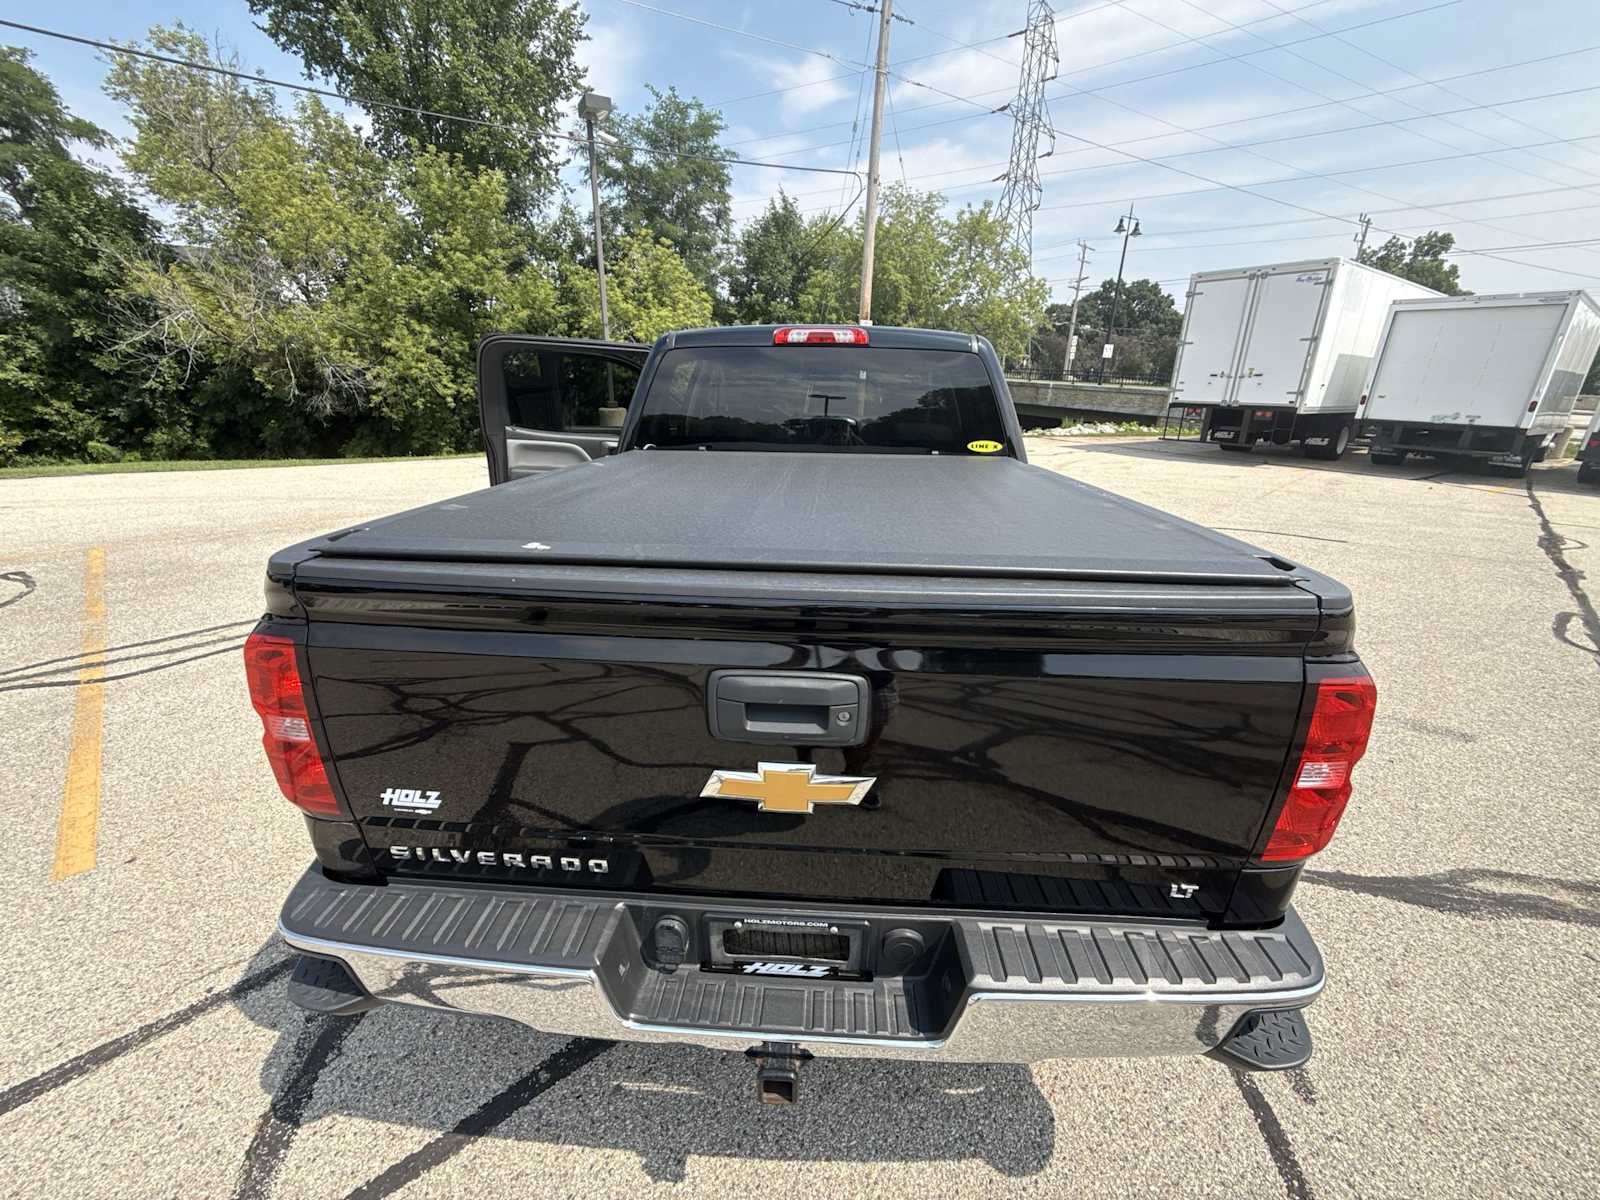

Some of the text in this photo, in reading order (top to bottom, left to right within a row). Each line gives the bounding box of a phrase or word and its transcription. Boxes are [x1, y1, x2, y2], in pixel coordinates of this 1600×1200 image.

[380, 788, 442, 809] HOLZ
[390, 845, 609, 873] SILVERADO
[1170, 883, 1199, 898] LT
[743, 918, 829, 928] HOLZMOTORS.COM
[743, 962, 831, 977] HOLZ
